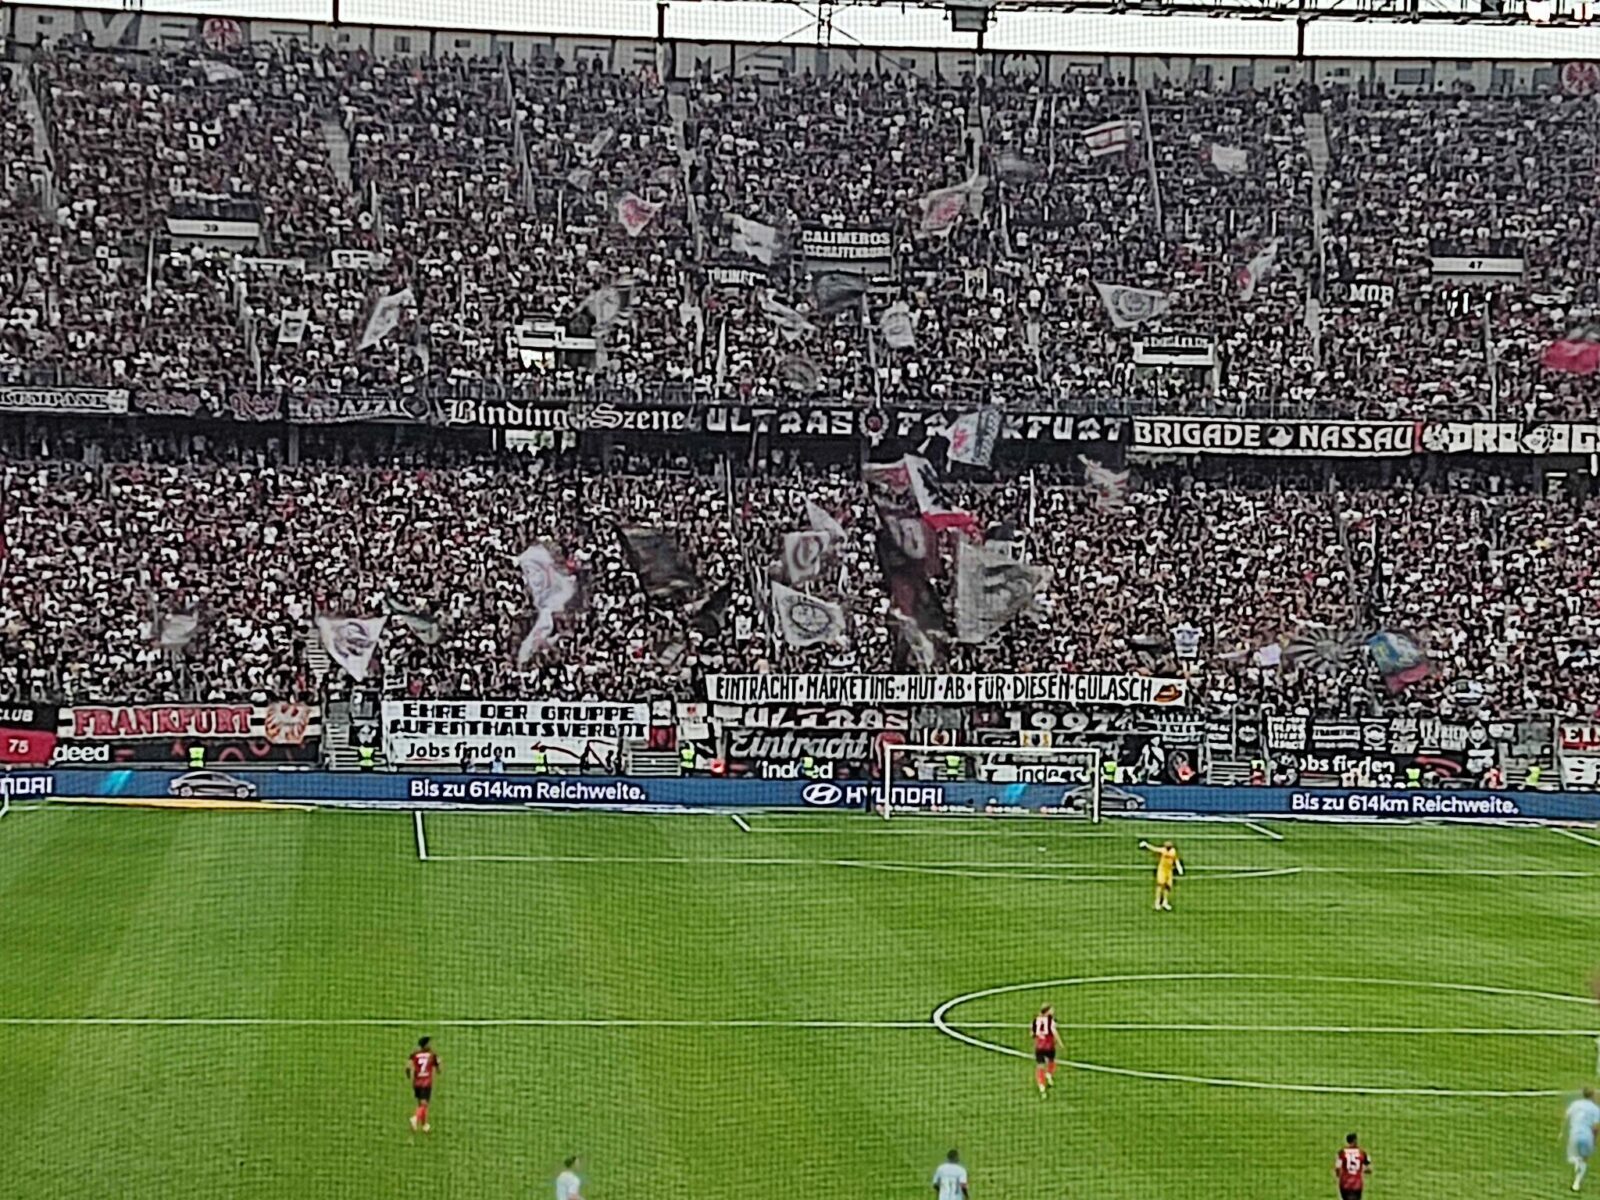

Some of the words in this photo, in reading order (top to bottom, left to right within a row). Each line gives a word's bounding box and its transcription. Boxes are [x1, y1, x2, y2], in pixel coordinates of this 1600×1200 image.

[802, 230, 890, 245] CALIMEROS
[1468, 261, 1484, 270] 47
[443, 399, 571, 431] Binding
[589, 403, 686, 432] Szene
[707, 408, 854, 435] ULTRAS
[897, 410, 1127, 441] FRKFURT
[1135, 420, 1262, 447] BRIGADE
[1299, 423, 1414, 451] NASSAU
[716, 676, 799, 700] EINTRACHT
[907, 676, 938, 700] HUT
[943, 676, 966, 700] AB
[974, 675, 1006, 701] FÜR
[1013, 675, 1070, 701] DIESEN
[1075, 677, 1153, 702] GULASCH
[73, 706, 254, 736] FRANKFURT
[403, 703, 466, 718] EHRE
[480, 704, 528, 719] DER
[541, 705, 635, 721] GRUPPE
[745, 706, 909, 730] ULTRAS
[8, 739, 29, 754] 75
[53, 744, 110, 761] deed
[406, 742, 450, 759] Jobs
[455, 742, 516, 759] finden
[730, 730, 868, 759] Eintracht
[1299, 754, 1330, 772] obs
[411, 780, 440, 797] Bis
[442, 784, 465, 797] zu
[470, 781, 530, 799] 614km
[533, 782, 647, 801] Reichweite.
[1292, 793, 1320, 810] Bis
[1322, 798, 1345, 811] zu
[1348, 795, 1409, 812] 614km
[1412, 796, 1520, 815] Reichweite.
